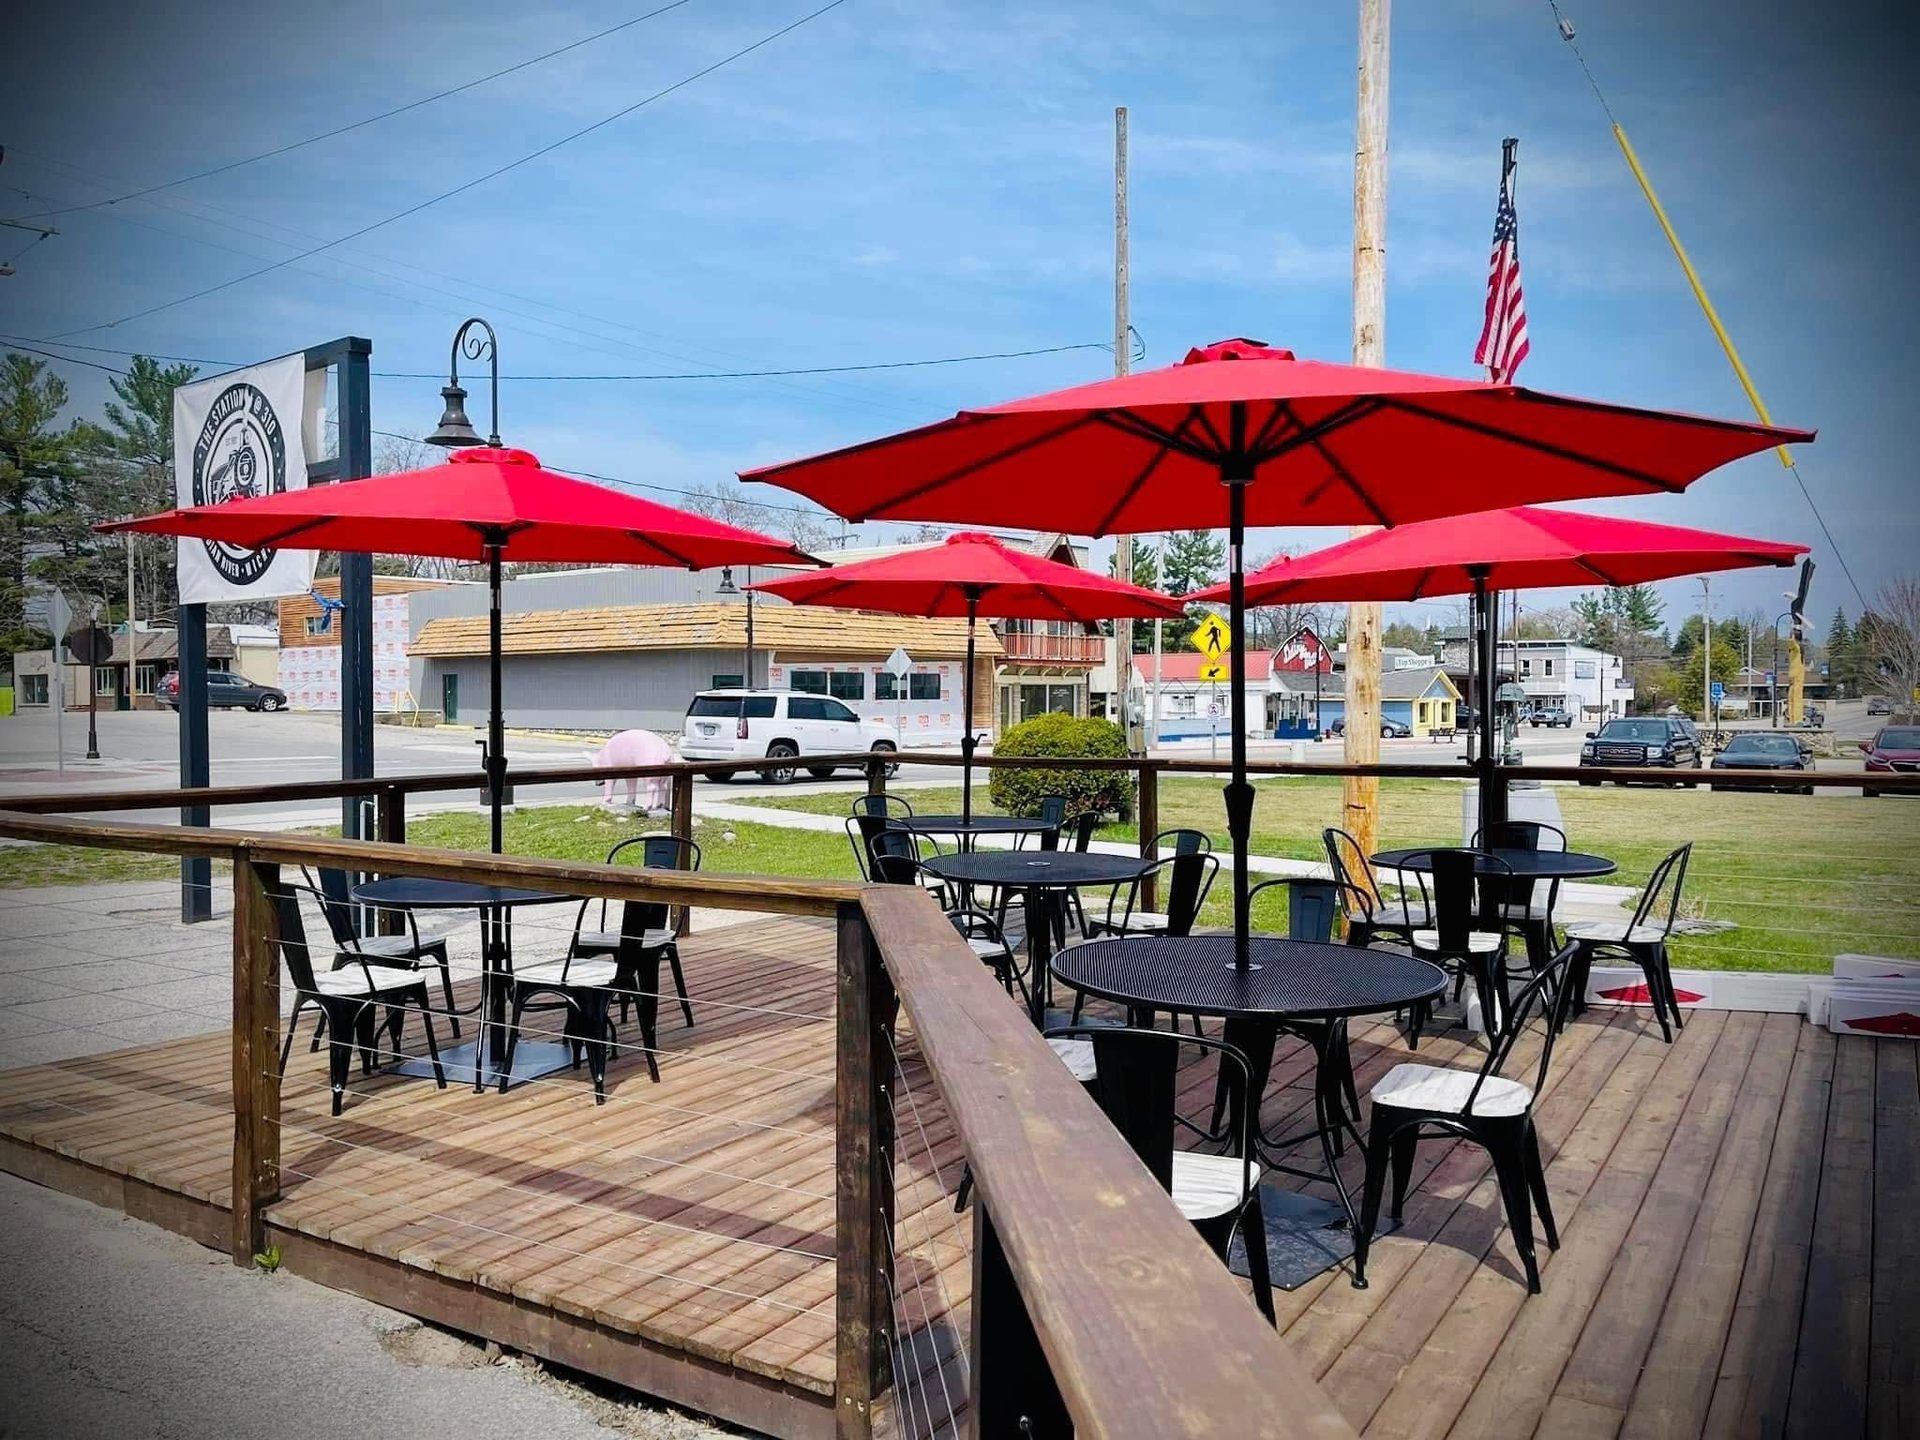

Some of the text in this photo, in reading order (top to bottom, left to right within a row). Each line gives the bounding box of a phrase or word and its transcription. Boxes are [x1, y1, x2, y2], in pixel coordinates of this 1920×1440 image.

[198, 421, 216, 451] THE
[212, 388, 244, 426] STATION
[261, 407, 276, 436] 310
[220, 555, 240, 577] RIVER
[245, 548, 271, 577] MICH
